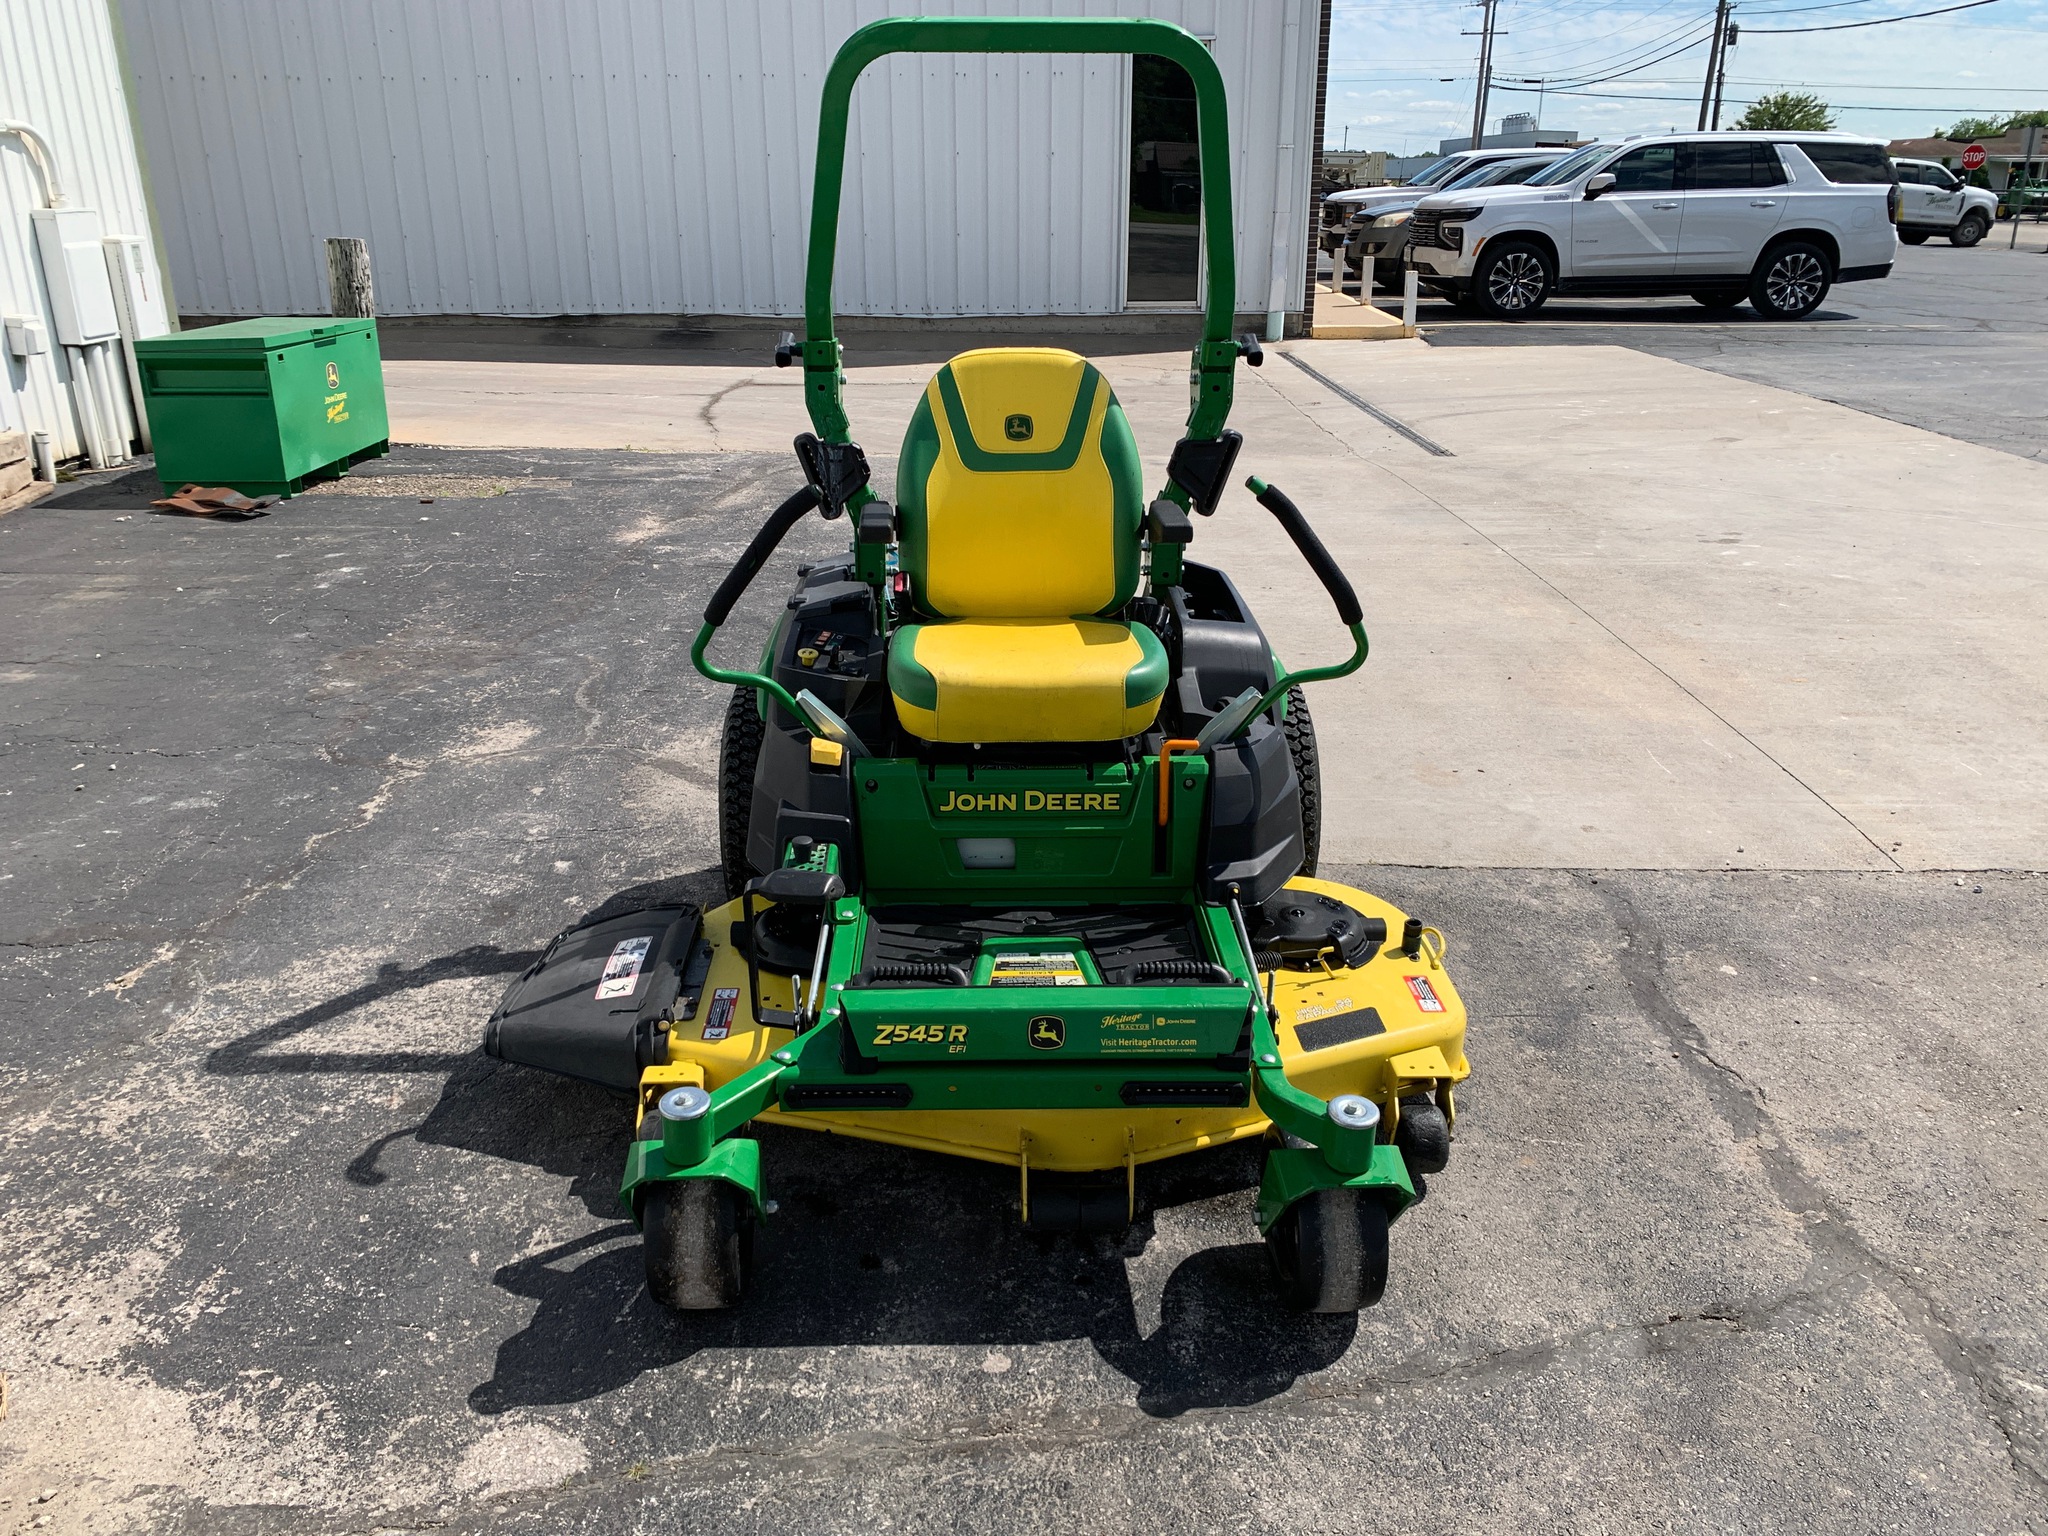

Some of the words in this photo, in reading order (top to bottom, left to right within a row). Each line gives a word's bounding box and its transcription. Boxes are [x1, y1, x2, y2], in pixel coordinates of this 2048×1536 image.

[1963, 152, 1985, 162] STOP
[939, 790, 1017, 812] JOHN
[1024, 790, 1121, 812] DEERE
[1100, 1013, 1142, 1028] Heritage
[948, 1024, 969, 1042] R
[948, 1045, 967, 1053] EFI
[1100, 1038, 1117, 1047] Visit
[1118, 1037, 1197, 1048] HeritageTractor.com
